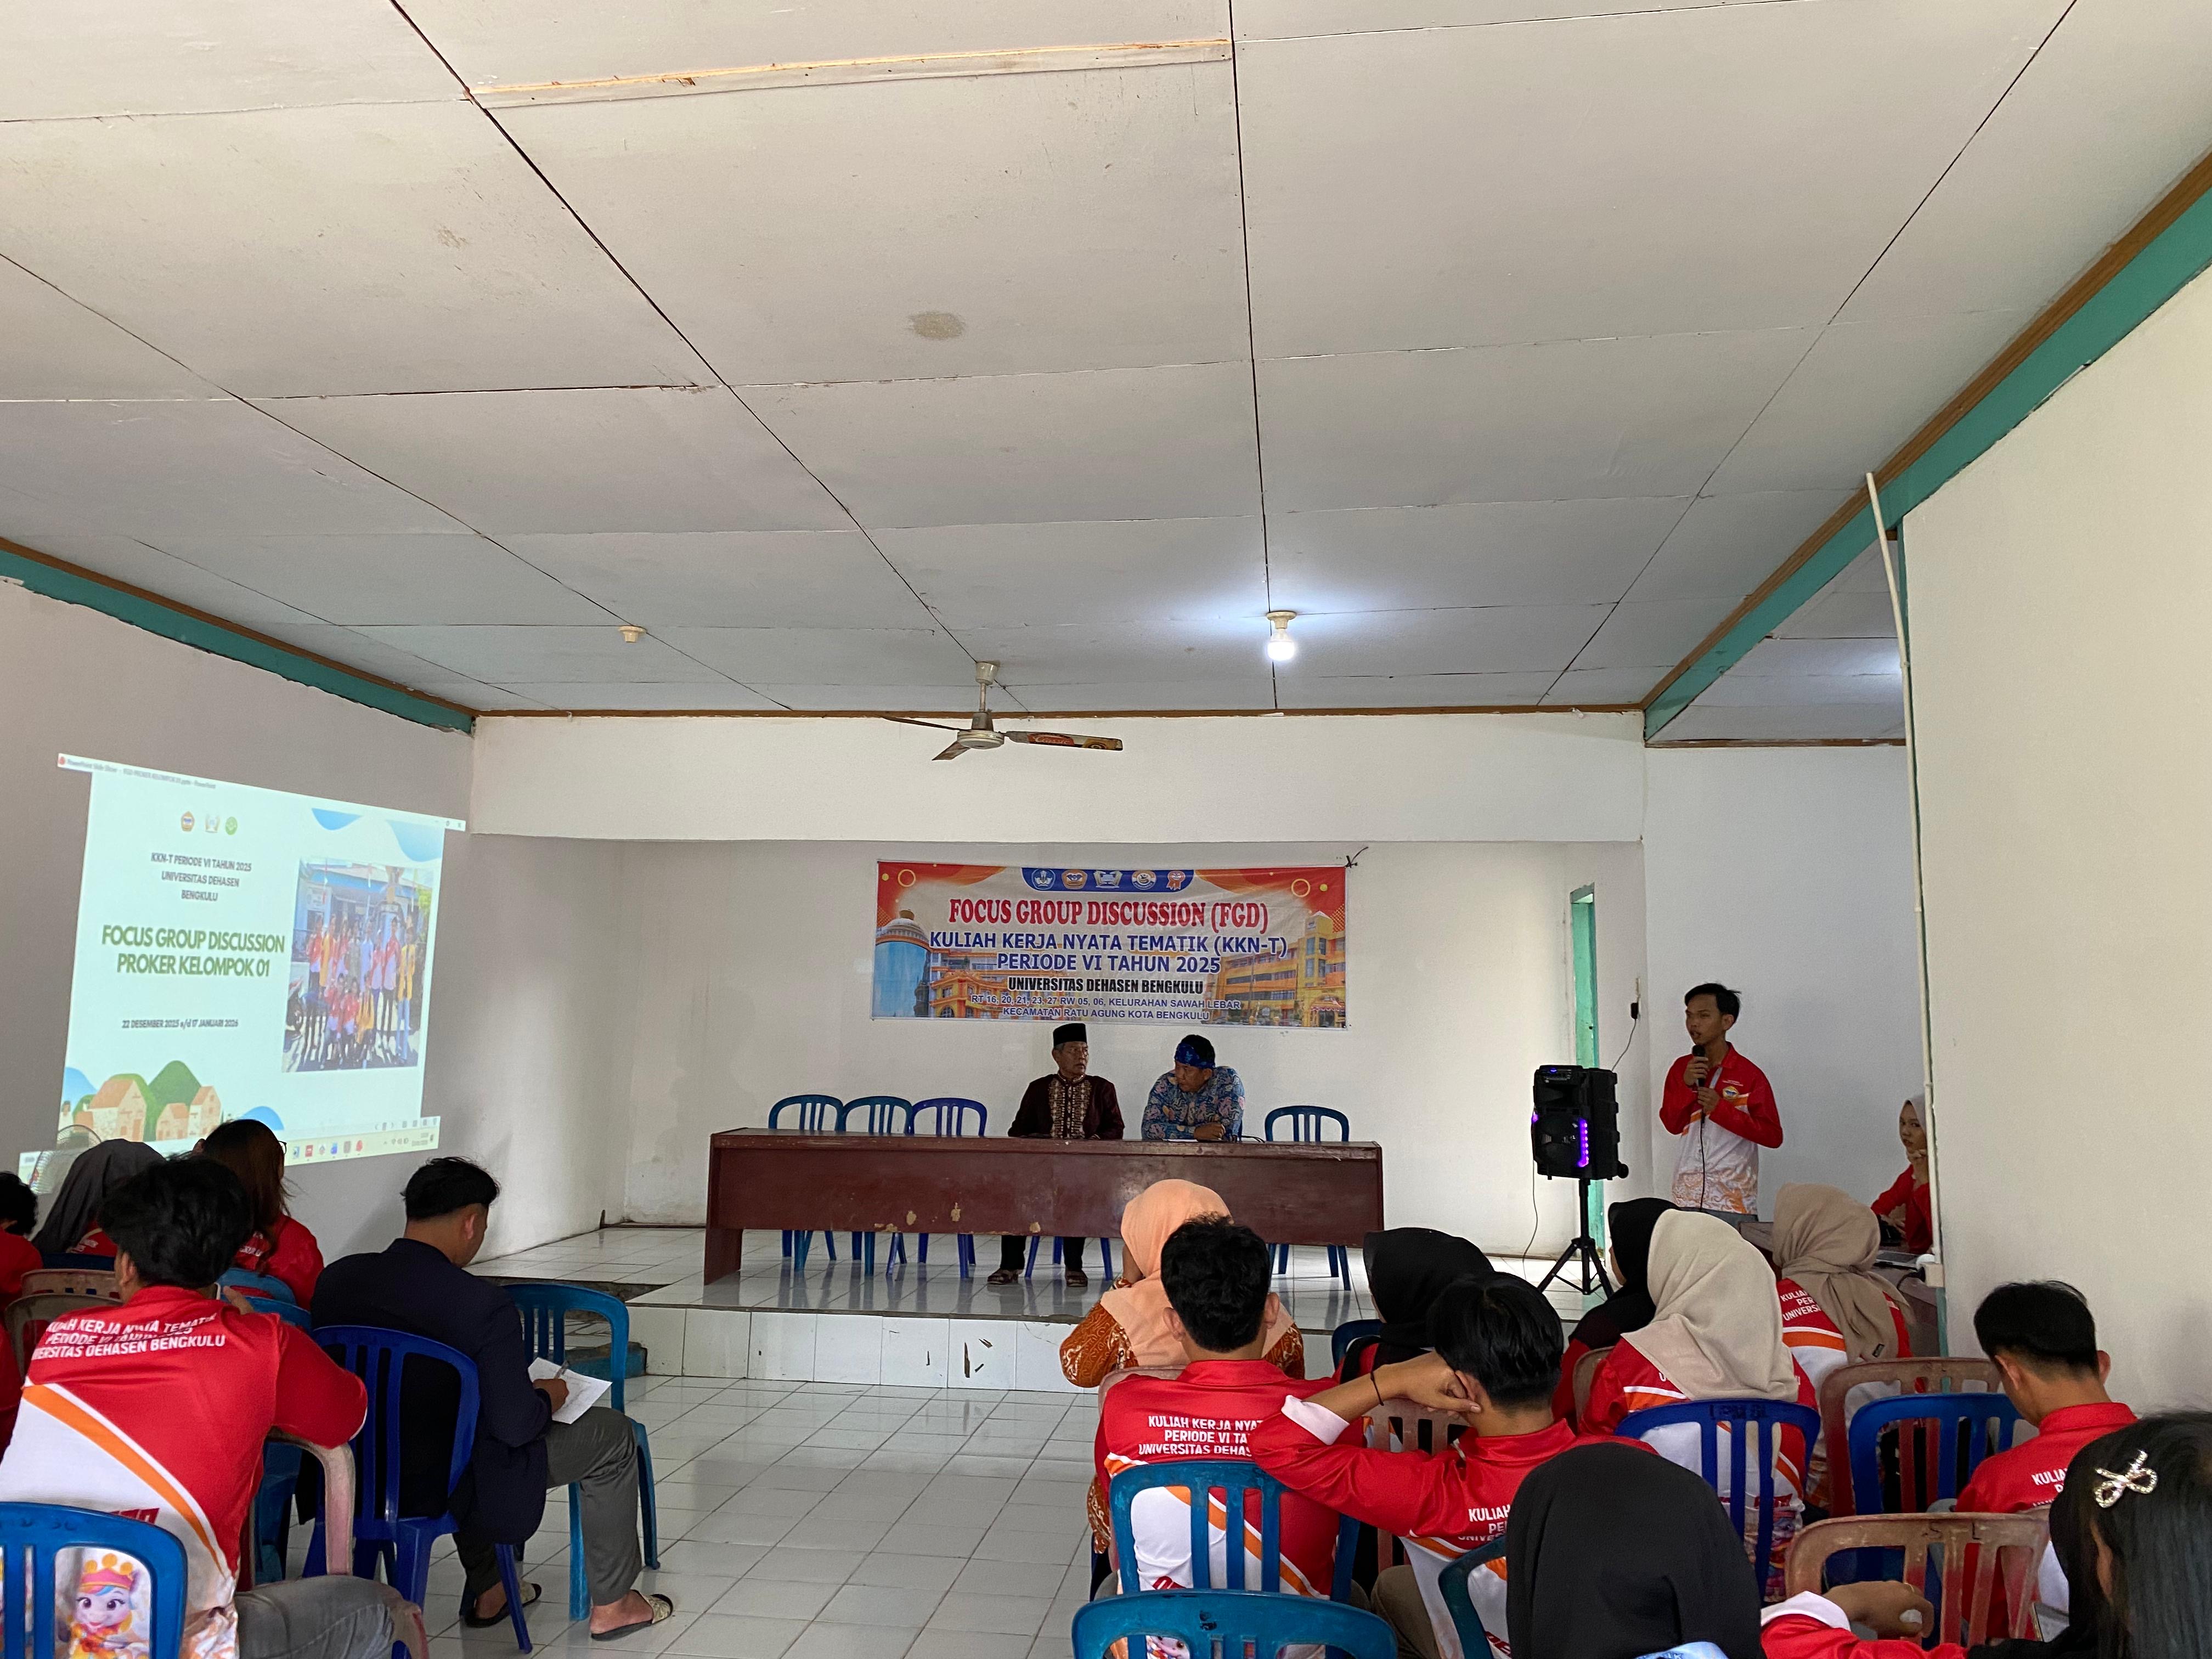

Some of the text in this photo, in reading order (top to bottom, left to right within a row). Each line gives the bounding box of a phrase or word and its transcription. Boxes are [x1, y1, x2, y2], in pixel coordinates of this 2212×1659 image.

[174, 855, 202, 867] PERIODE
[204, 858, 211, 868] VI
[212, 859, 235, 870] TAHUN
[236, 862, 252, 872] 2025
[161, 871, 240, 887] UNIVERSITAS DEHASEN
[181, 889, 218, 901] BENGKULU
[949, 899, 1268, 934] FOCUS GROUP DISCUSSION (FGD)
[102, 924, 285, 953] FOCUS GROUP DISCUSSION
[930, 932, 1287, 957] KULIAH KERJA NYATA TEMATIK (KKN-T)
[117, 953, 270, 977] PROKER KELOMPOK 01
[997, 953, 1220, 973] PERIODE VI TAHUN 2025
[1008, 977, 1203, 994] UNIVERSITAS DEHASEN BENGKULU
[1001, 996, 1014, 1004] 20,
[1017, 996, 1029, 1005] 21,
[1032, 996, 1044, 1005] 23,
[1078, 997, 1090, 1006] 05,
[1093, 998, 1105, 1006] 06,
[1109, 998, 1167, 1007] KELURAHAN
[1170, 1000, 1204, 1008] SAWAH
[1208, 1001, 1240, 1009] LEBAR
[1003, 1008, 1062, 1016] KECAMATAN
[1091, 1009, 1125, 1018] AGUNG
[1128, 1010, 1154, 1019] KOTA
[1156, 1011, 1209, 1020] BENGKULU
[131, 1019, 164, 1029] DESEMBER
[85, 1340, 147, 1357] DEHASEN
[150, 1335, 225, 1351] BENGKULU
[1148, 1415, 1189, 1429] KULIAH
[1192, 1418, 1231, 1431] KERJA
[1164, 1430, 1215, 1443] PERIODE
[1217, 1431, 1230, 1444] VI
[1138, 1443, 1211, 1455] UNIVERSITAS
[2031, 1468, 2068, 1486] KULIA
